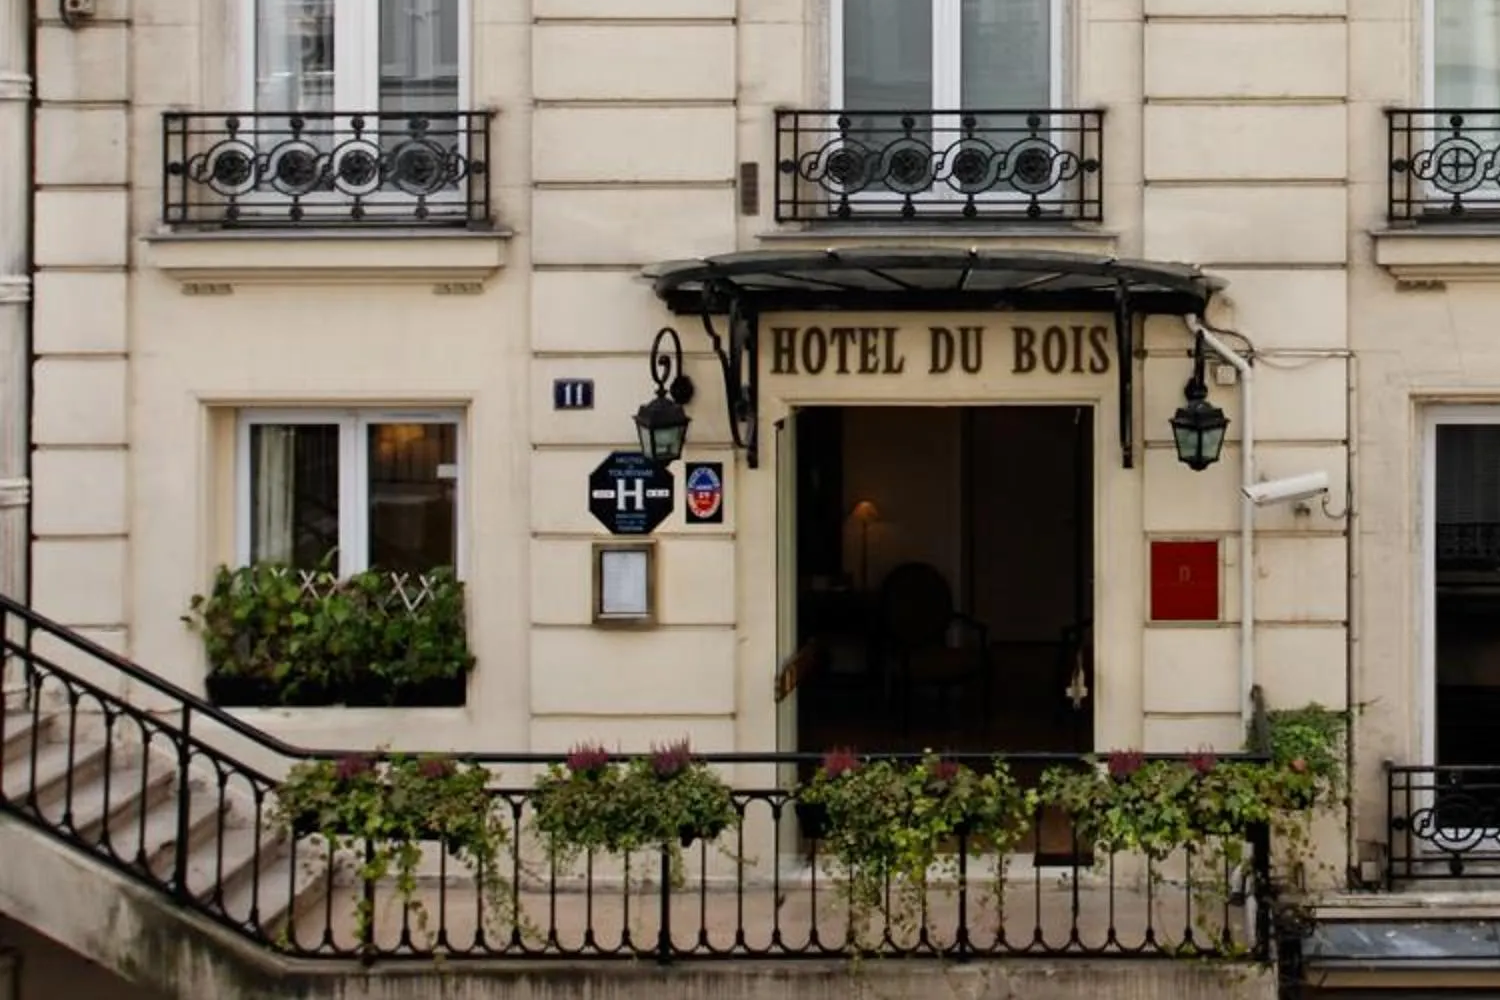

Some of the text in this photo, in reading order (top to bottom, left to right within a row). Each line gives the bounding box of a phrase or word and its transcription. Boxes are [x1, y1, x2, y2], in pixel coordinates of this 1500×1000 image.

[770, 325, 1110, 375] HOTEL DU BOIS
[565, 383, 583, 406] 11
[616, 478, 645, 511] H
